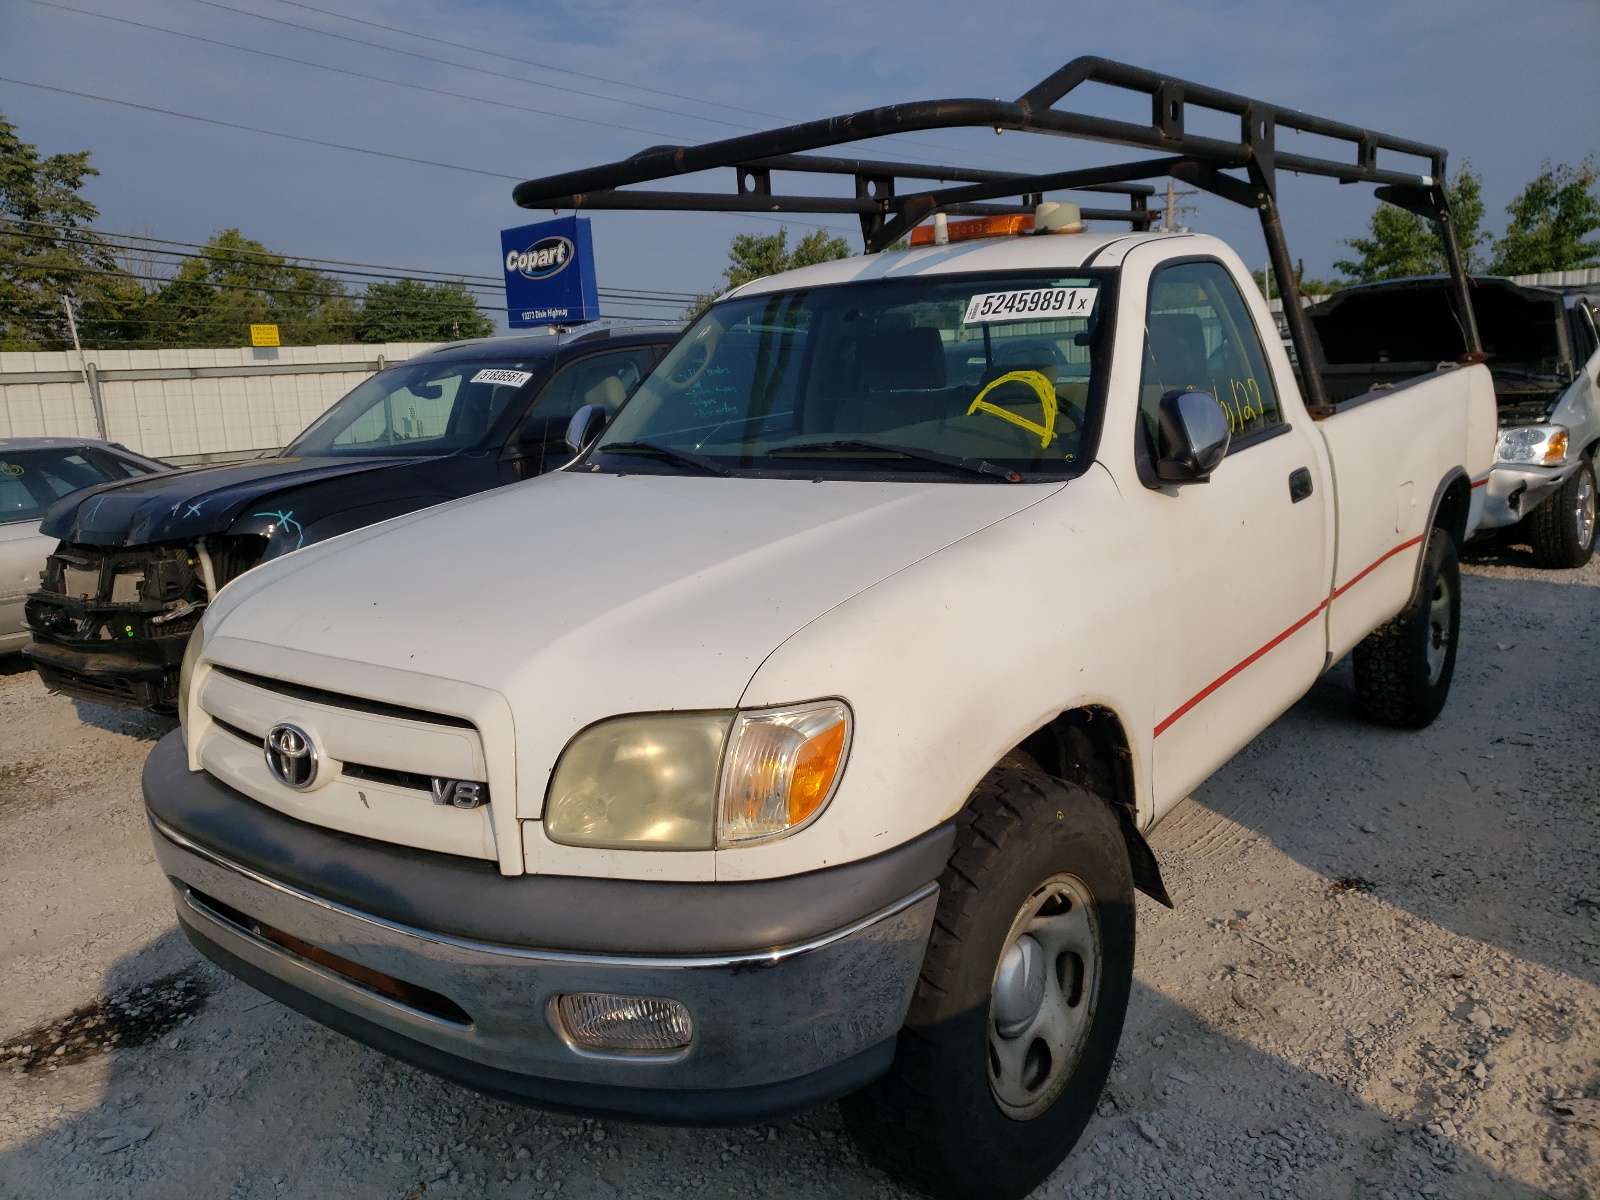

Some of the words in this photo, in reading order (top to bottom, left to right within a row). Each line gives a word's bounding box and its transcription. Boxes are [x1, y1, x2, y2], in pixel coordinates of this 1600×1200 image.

[506, 240, 566, 274] Copart
[535, 309, 547, 319] Dixie
[547, 307, 568, 319] Highway
[981, 290, 1078, 315] 52459891
[431, 778, 480, 810] V8
